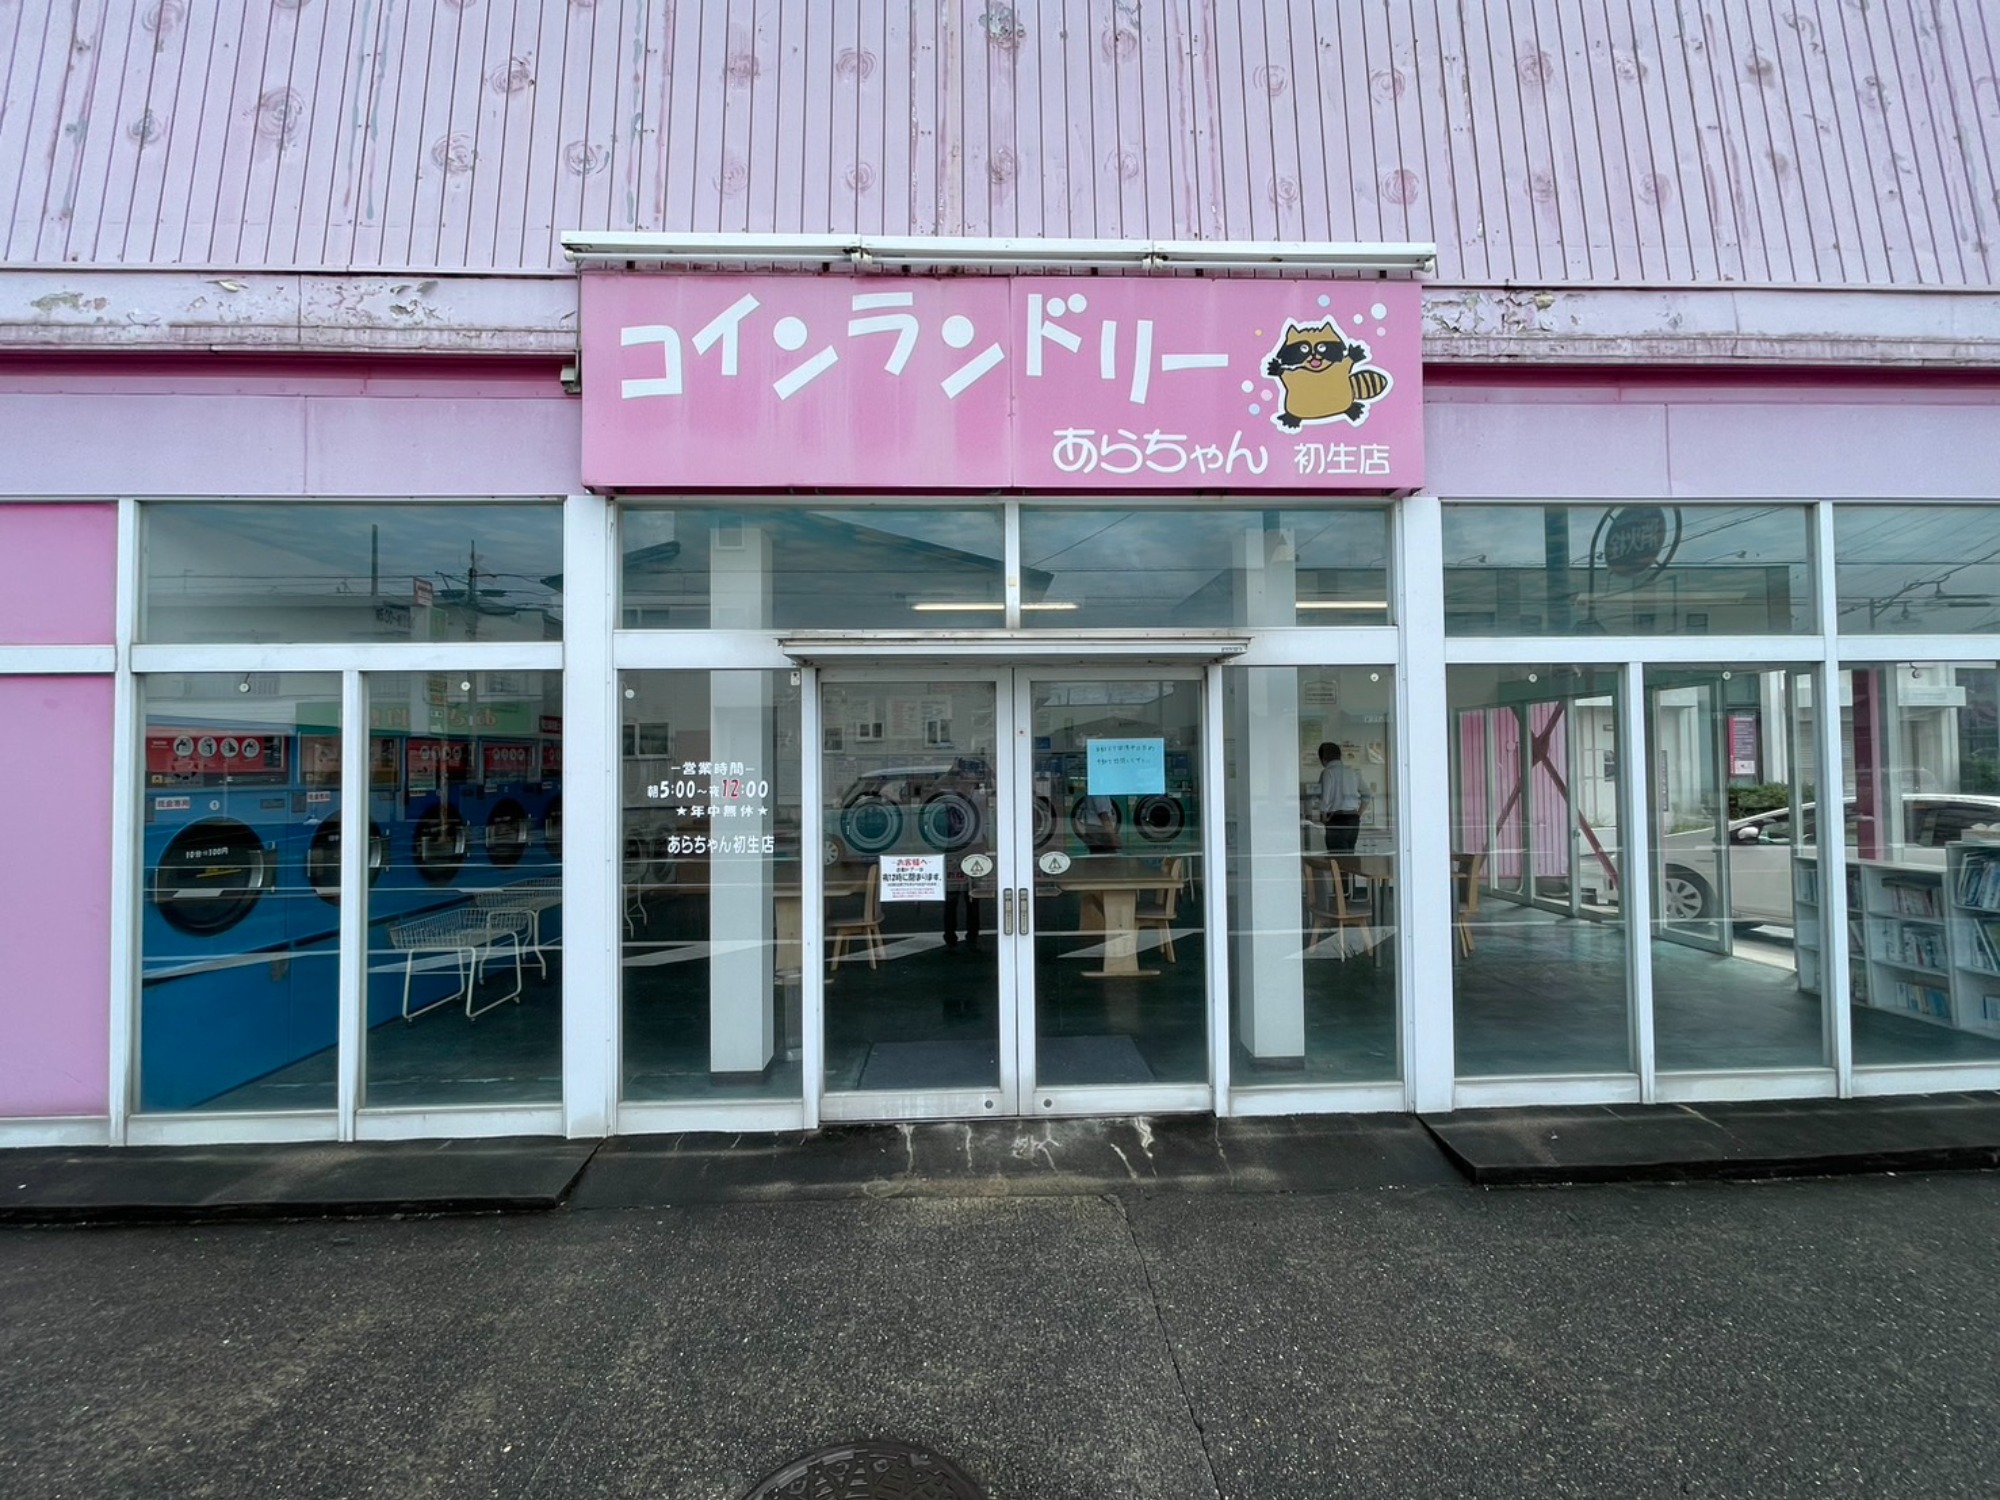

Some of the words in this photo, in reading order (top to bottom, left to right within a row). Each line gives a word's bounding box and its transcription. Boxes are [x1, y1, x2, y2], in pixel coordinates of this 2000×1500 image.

[621, 292, 1229, 404] コインランドリー
[1052, 428, 1268, 474] あらちゃん
[1294, 442, 1391, 475] 初生店
[667, 834, 775, 854] あらちゃん初生店
